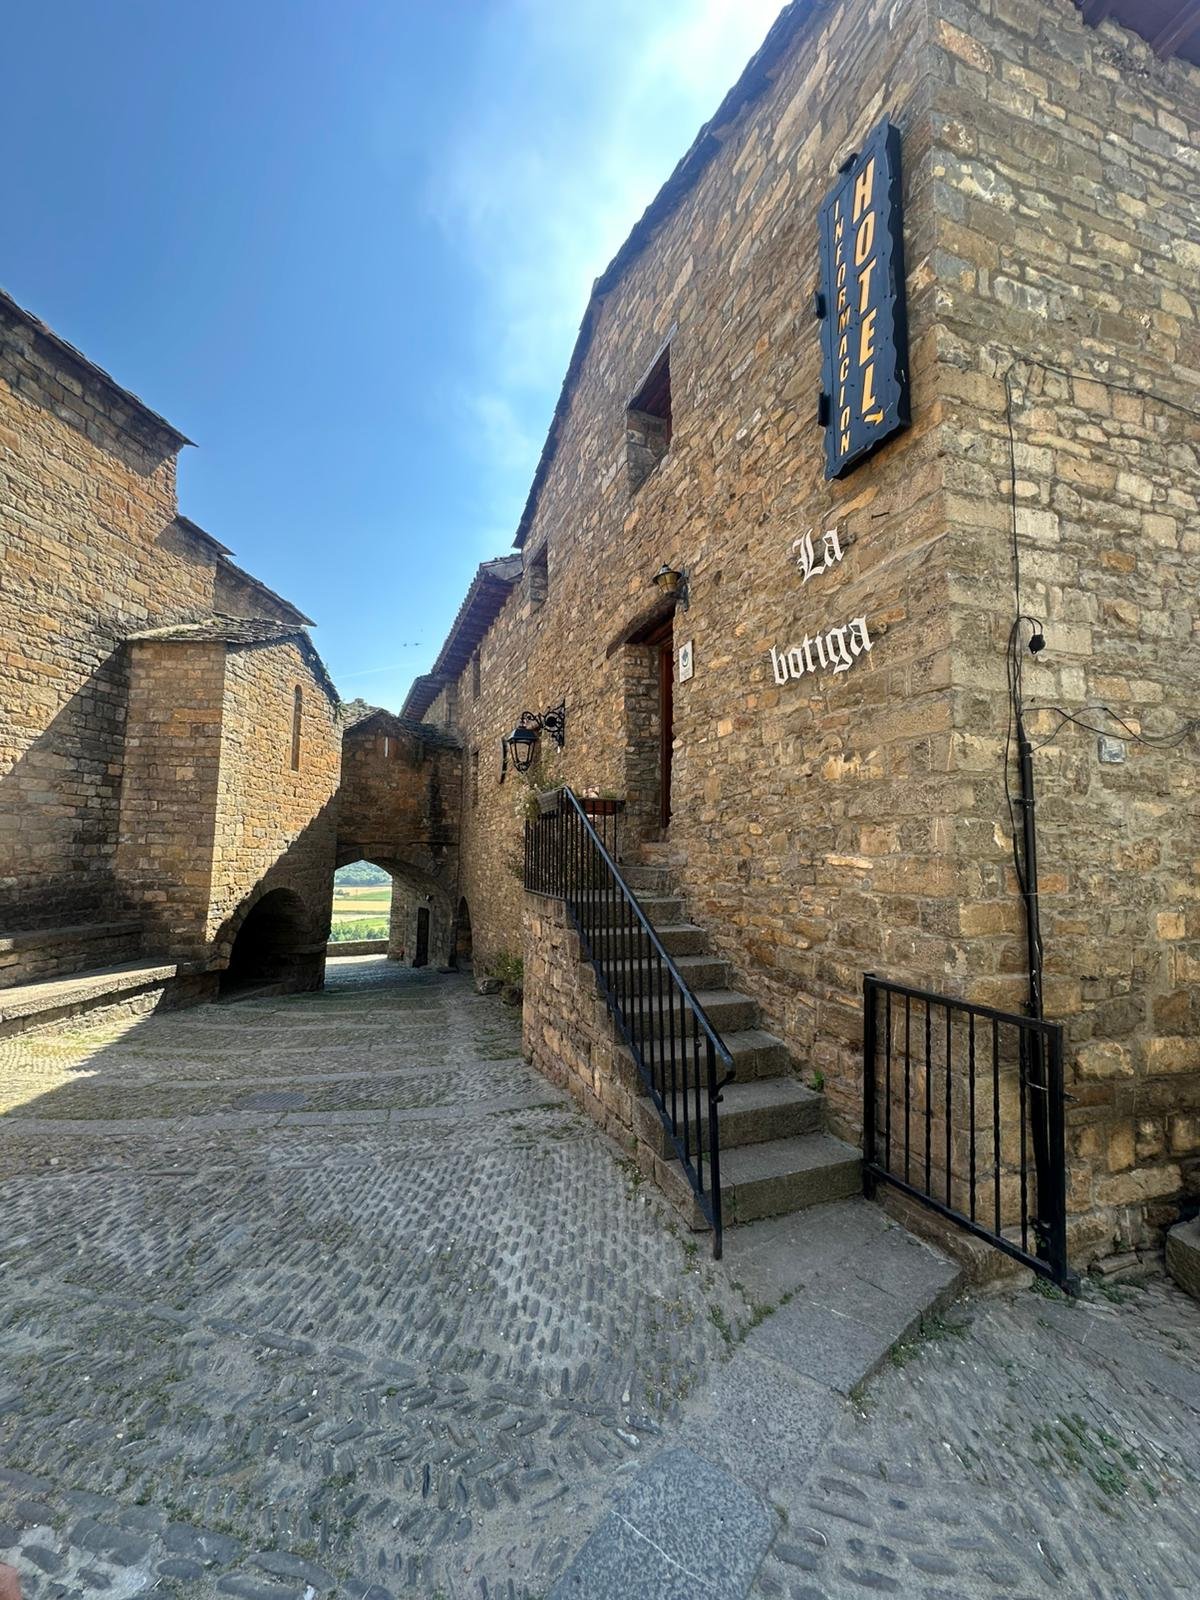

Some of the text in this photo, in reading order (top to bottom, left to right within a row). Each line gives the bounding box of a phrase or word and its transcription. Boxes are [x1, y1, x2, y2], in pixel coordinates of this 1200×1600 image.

[834, 199, 851, 456] INFORMACION
[852, 157, 877, 414] HOTEL
[792, 527, 845, 584] La
[769, 615, 875, 685] botiga
